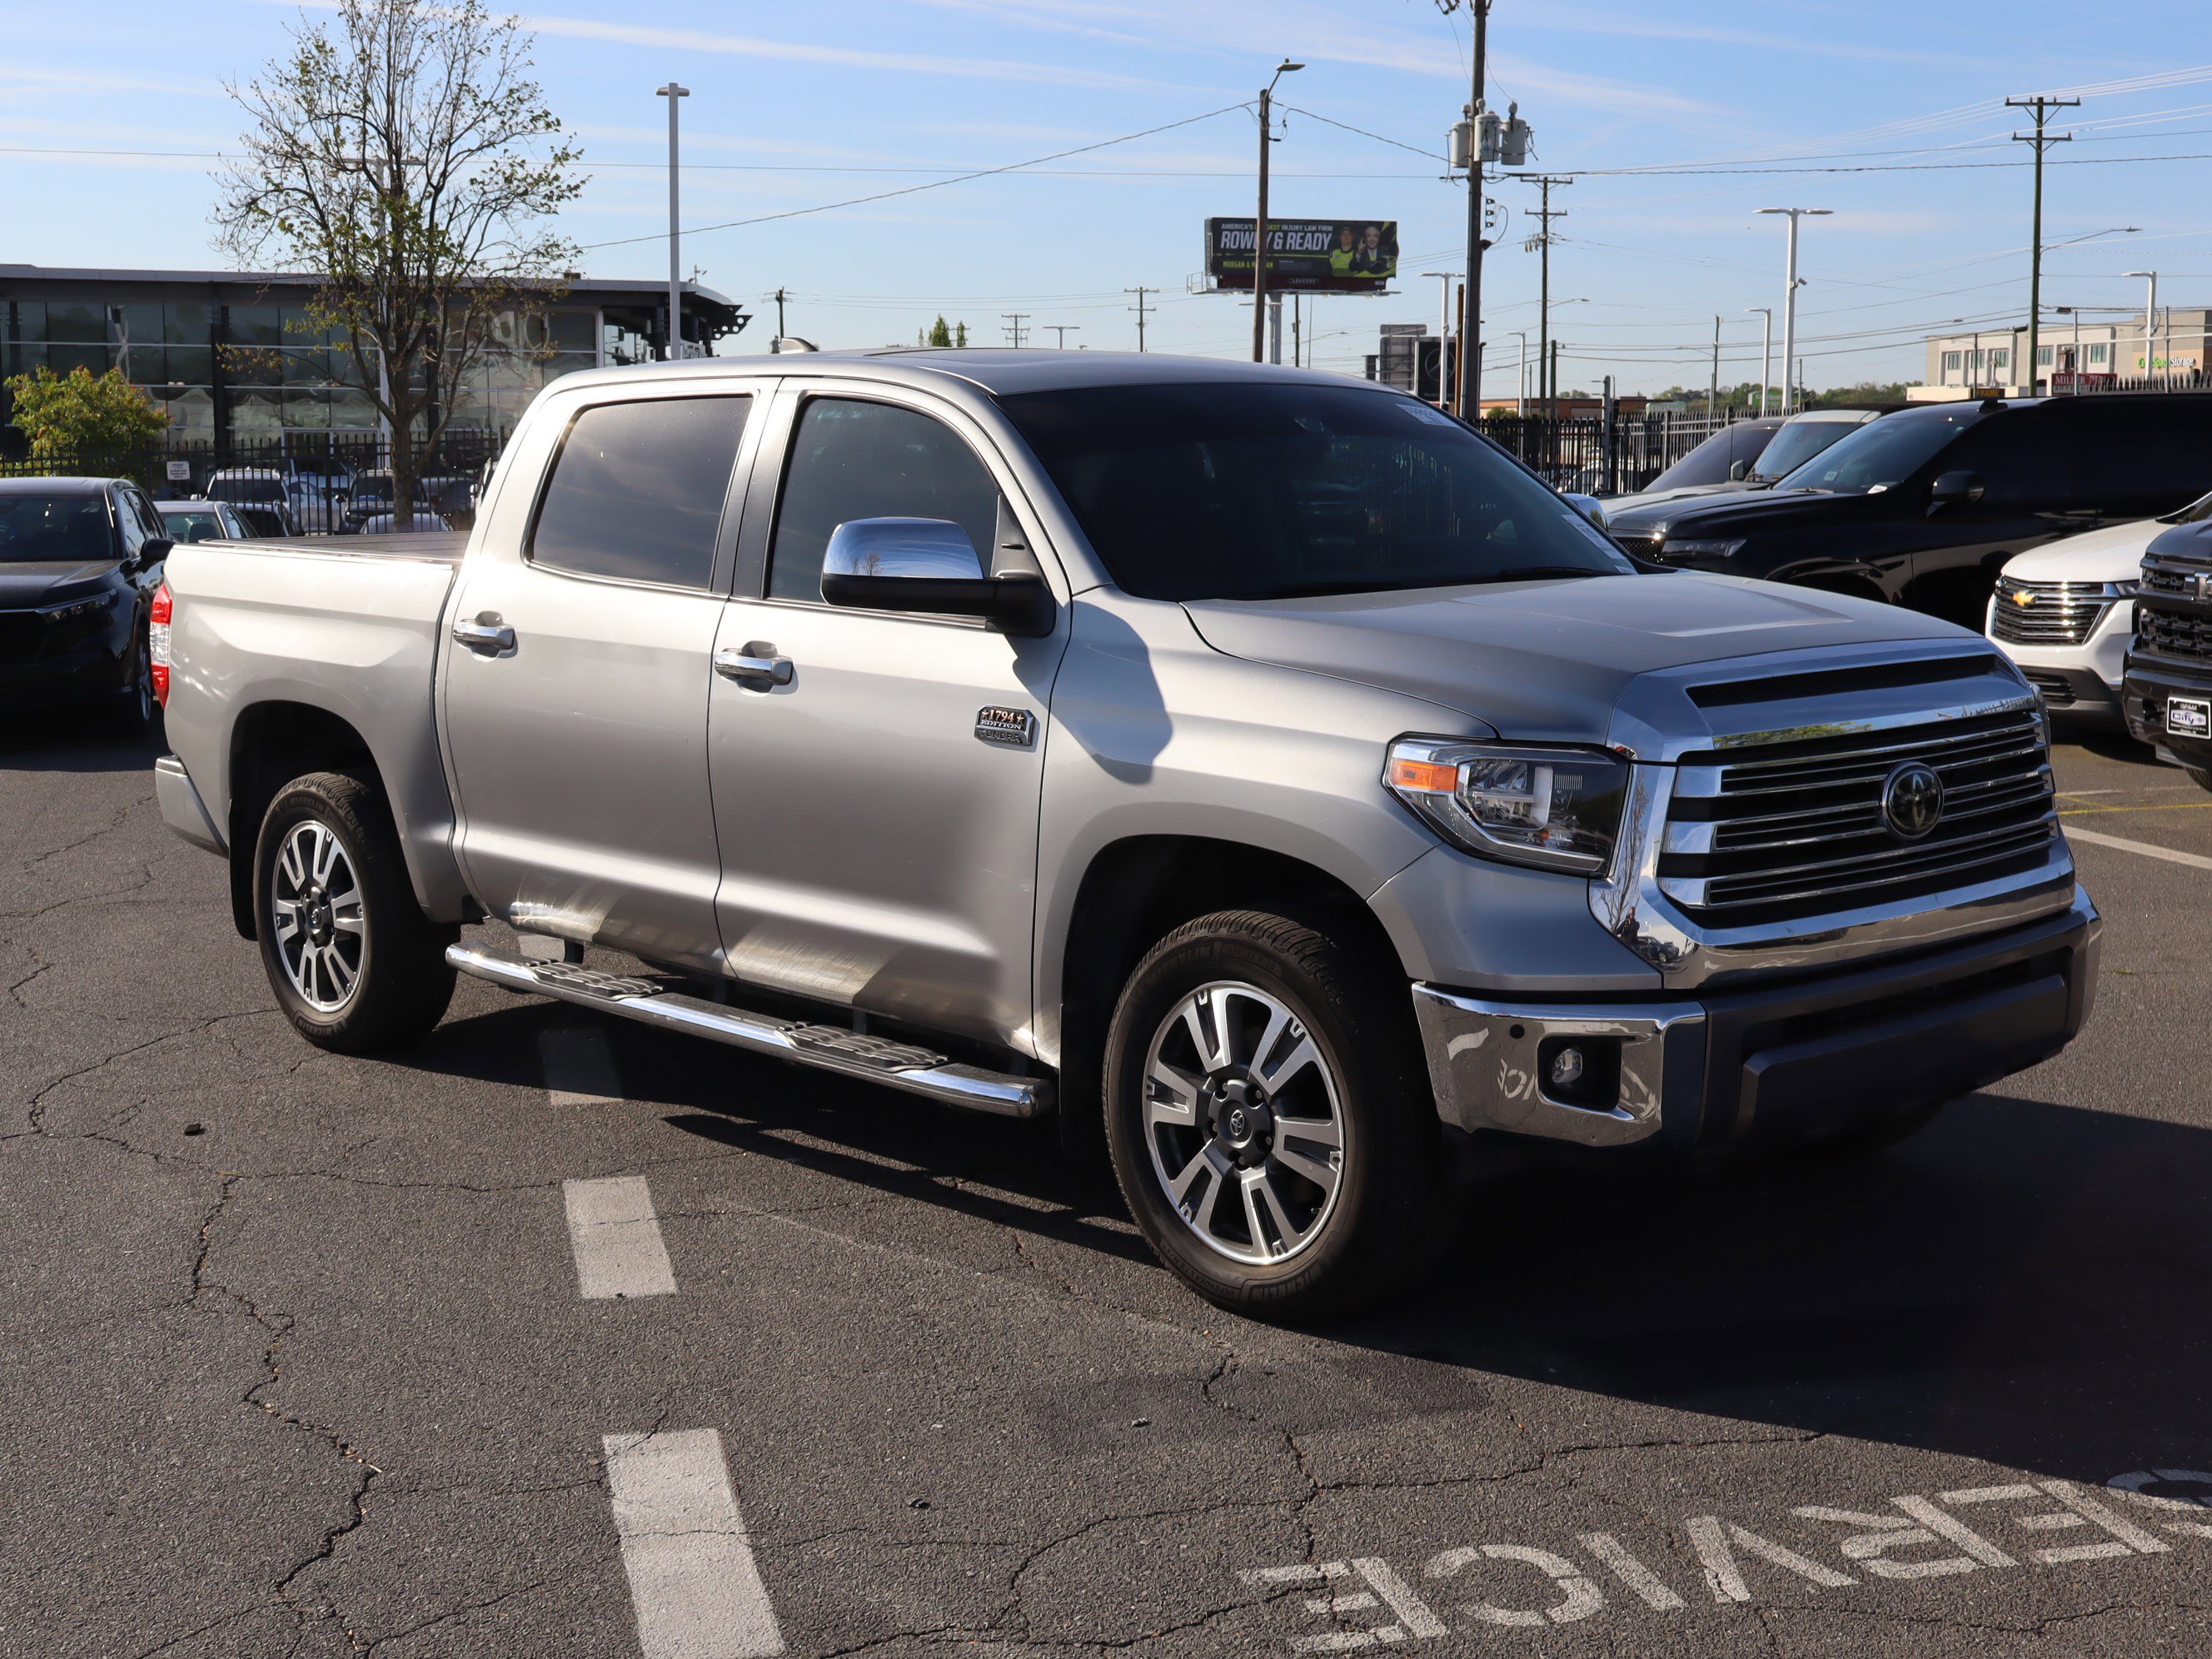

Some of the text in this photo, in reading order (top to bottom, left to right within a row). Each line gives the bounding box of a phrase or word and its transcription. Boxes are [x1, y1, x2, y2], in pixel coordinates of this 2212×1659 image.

[1273, 232, 1284, 250] &
[1286, 232, 1333, 251] READY
[2170, 356, 2196, 368] Storage
[989, 709, 1014, 723] 1794
[980, 720, 1022, 730] EDITION
[979, 730, 1021, 743] TUNDRA
